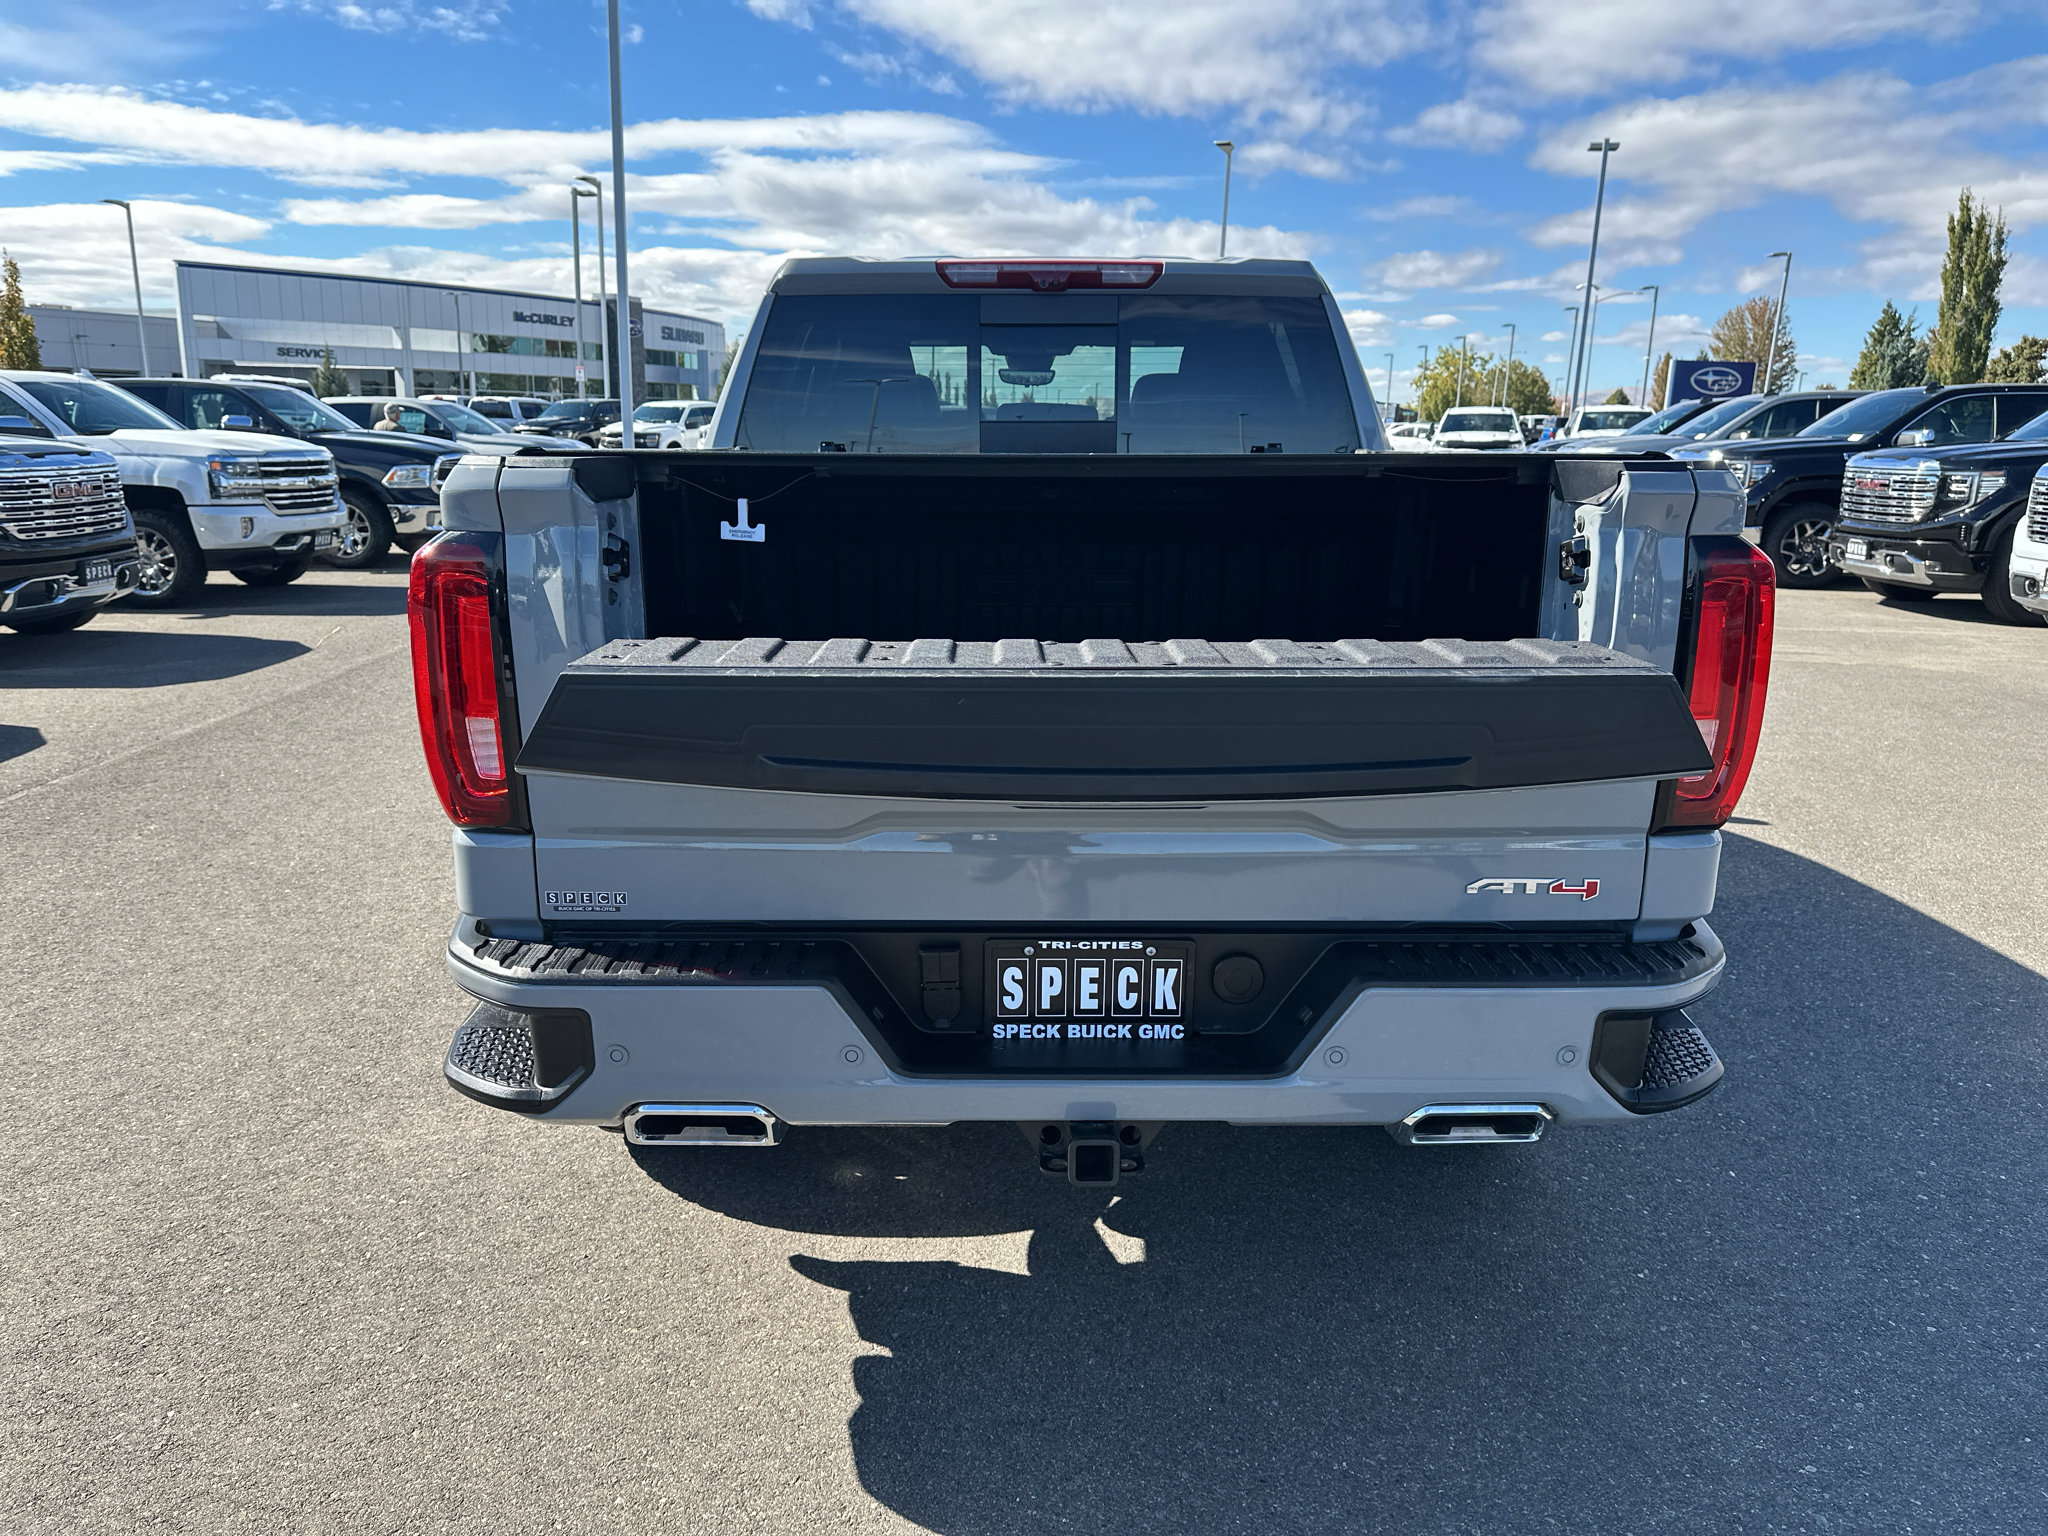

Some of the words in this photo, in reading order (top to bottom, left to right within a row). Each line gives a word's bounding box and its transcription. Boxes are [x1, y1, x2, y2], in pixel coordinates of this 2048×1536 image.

[513, 311, 575, 327] McCURLEY
[277, 347, 335, 360] SERVICE
[55, 481, 103, 498] GMC
[85, 564, 112, 580] SPECK
[1466, 877, 1601, 901] AT4
[548, 892, 626, 904] SPECK
[1037, 940, 1144, 950] TRI-CITIES
[1002, 966, 1178, 1010] SPECK
[992, 1023, 1061, 1039] SPECK
[1067, 1023, 1133, 1039] BUICK
[1138, 1023, 1185, 1040] GMC
